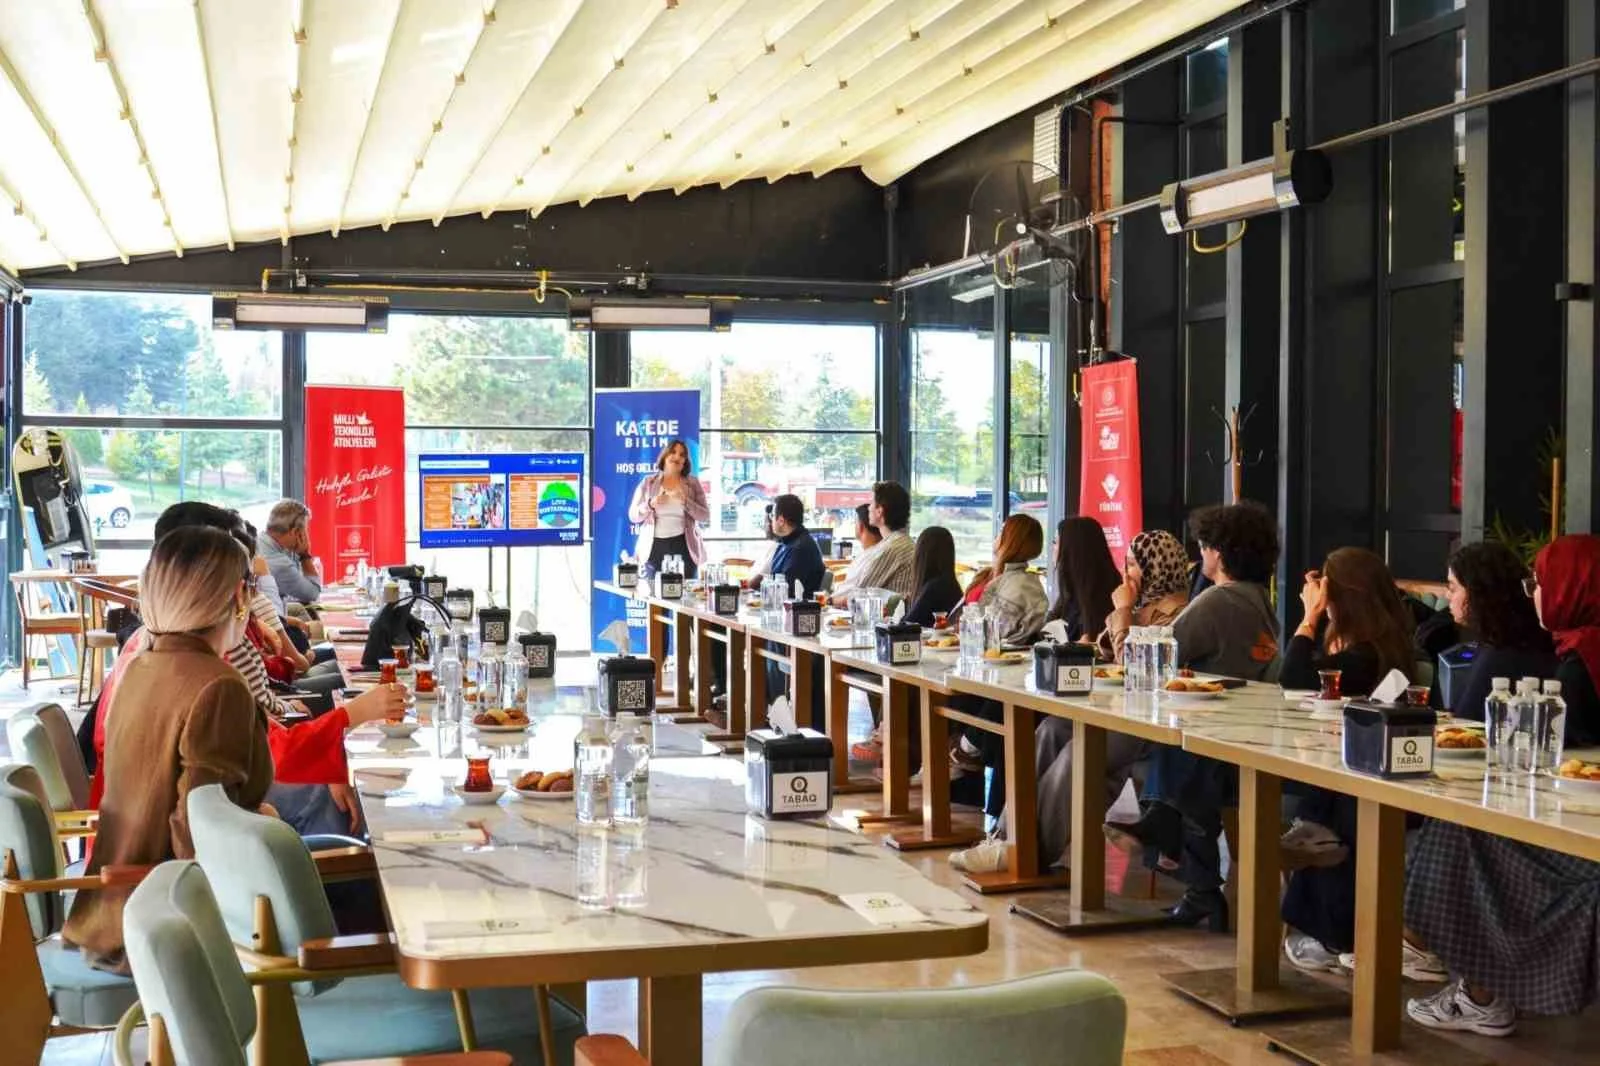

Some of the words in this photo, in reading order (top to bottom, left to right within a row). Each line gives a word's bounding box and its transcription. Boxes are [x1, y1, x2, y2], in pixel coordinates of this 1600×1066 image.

[615, 463, 635, 475] HOŞ
[1396, 755, 1424, 764] TABAQ
[783, 794, 817, 803] TABAQ
